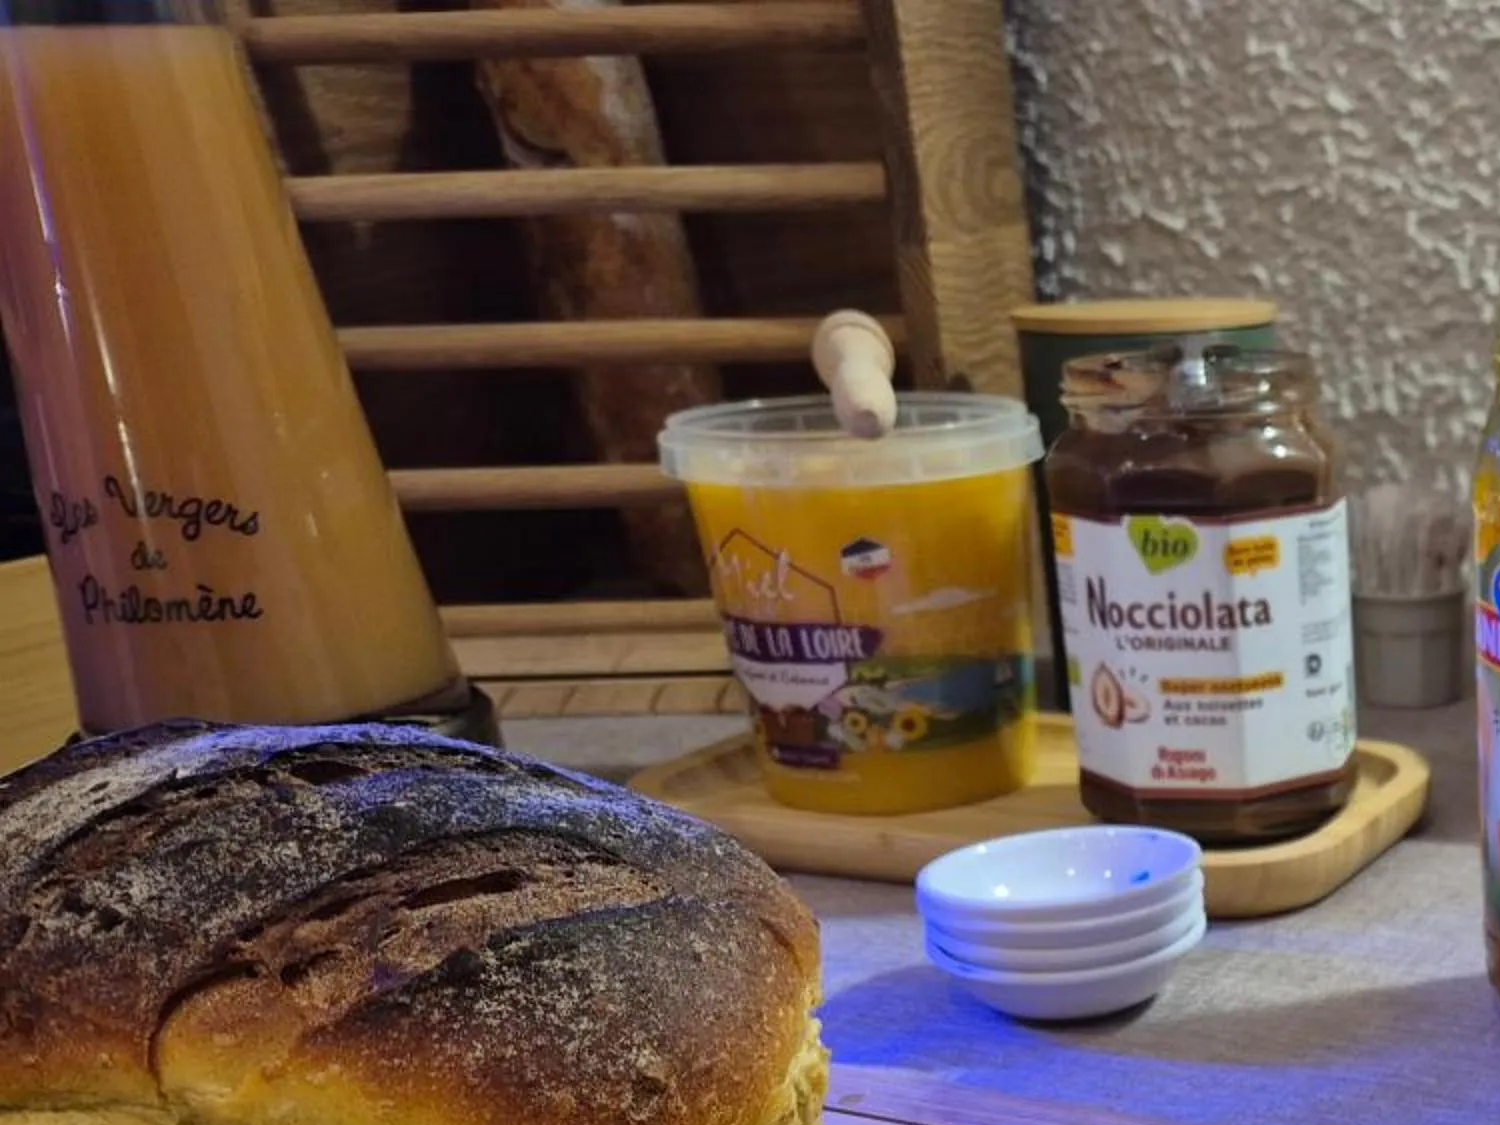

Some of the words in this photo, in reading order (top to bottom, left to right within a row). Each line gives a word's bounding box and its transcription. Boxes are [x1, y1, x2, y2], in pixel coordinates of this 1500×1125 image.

[104, 475, 261, 542] Vergers
[130, 541, 169, 571] de
[1141, 531, 1189, 559] bio
[79, 574, 265, 626] Philomène
[1085, 575, 1273, 631] Nocciolata
[800, 626, 866, 660] LOIRE
[1115, 635, 1231, 652] L'ORIGINALE
